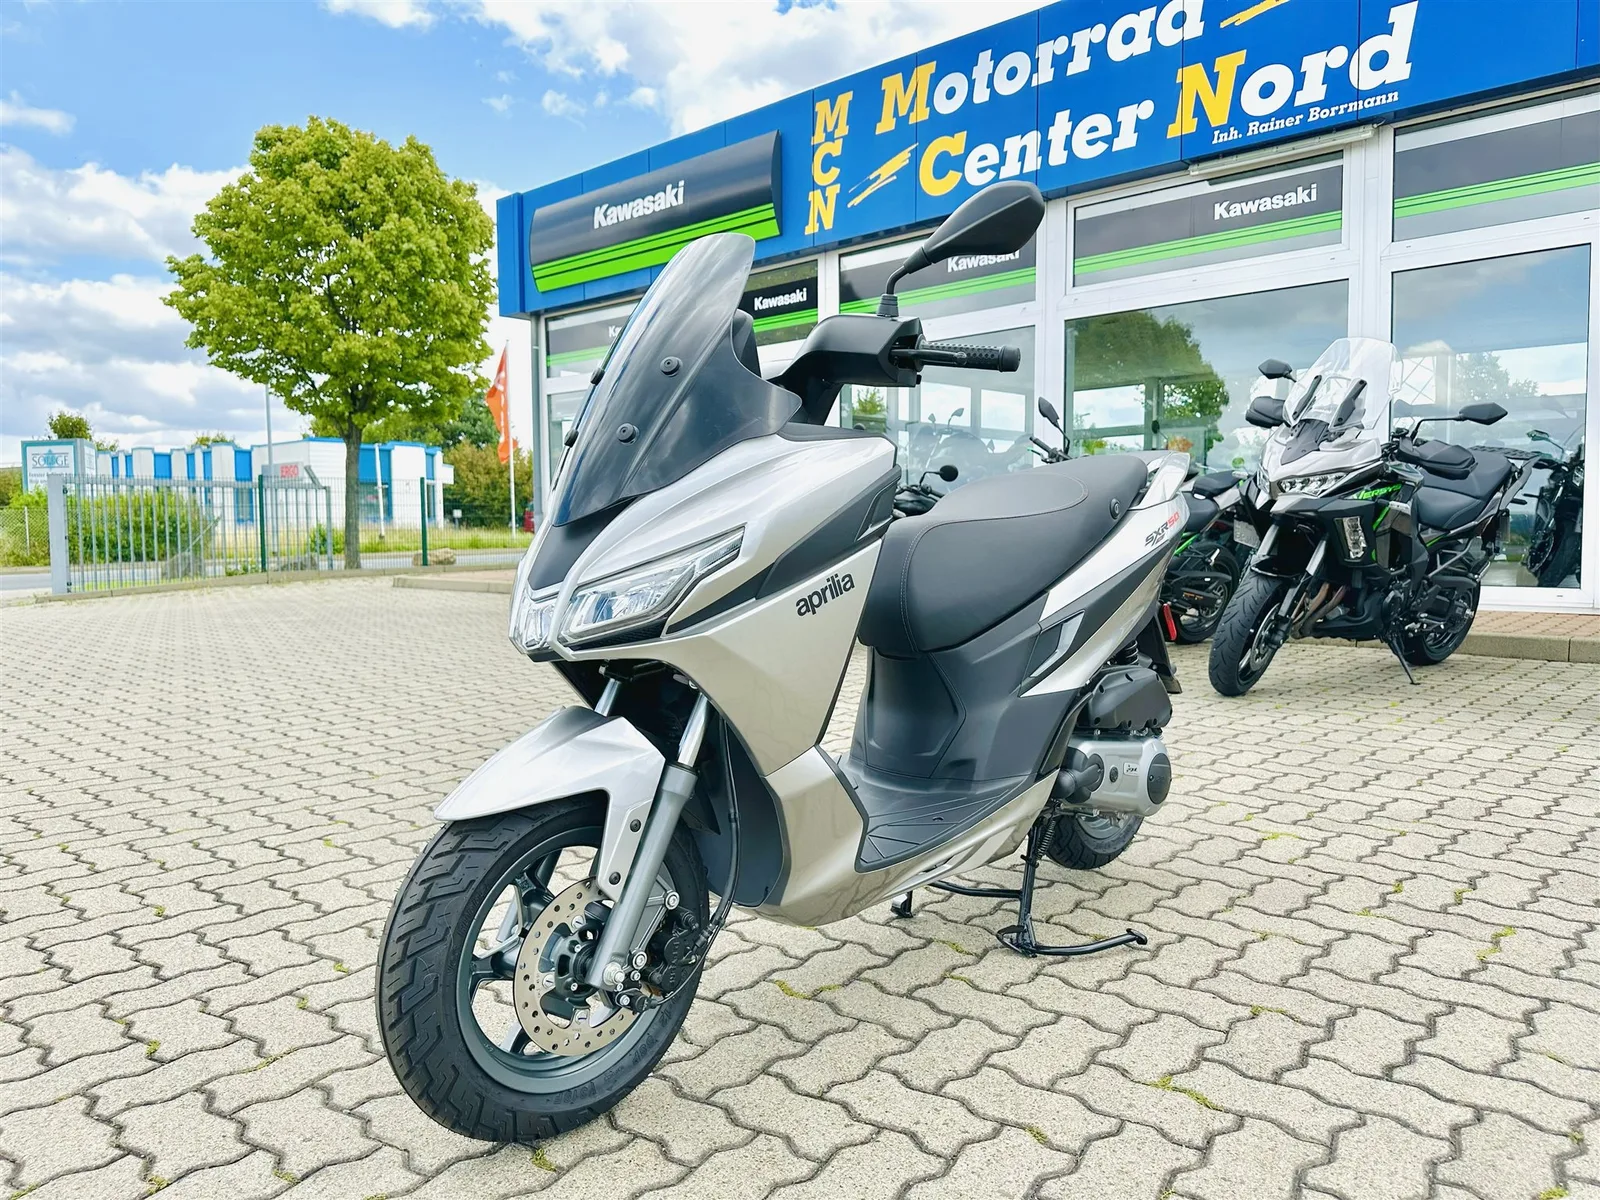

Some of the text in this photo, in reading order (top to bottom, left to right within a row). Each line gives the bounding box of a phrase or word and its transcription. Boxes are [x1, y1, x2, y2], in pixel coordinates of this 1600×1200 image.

[875, 0, 1205, 135] Motorrad
[919, 0, 1419, 197] Center Nord
[1212, 91, 1399, 144] Inh. Rainer Borrmann
[593, 180, 685, 230] Kawasaki
[1213, 183, 1317, 220] Kawasaki
[754, 287, 807, 311] Kawasaki
[796, 573, 855, 617] aprilia
